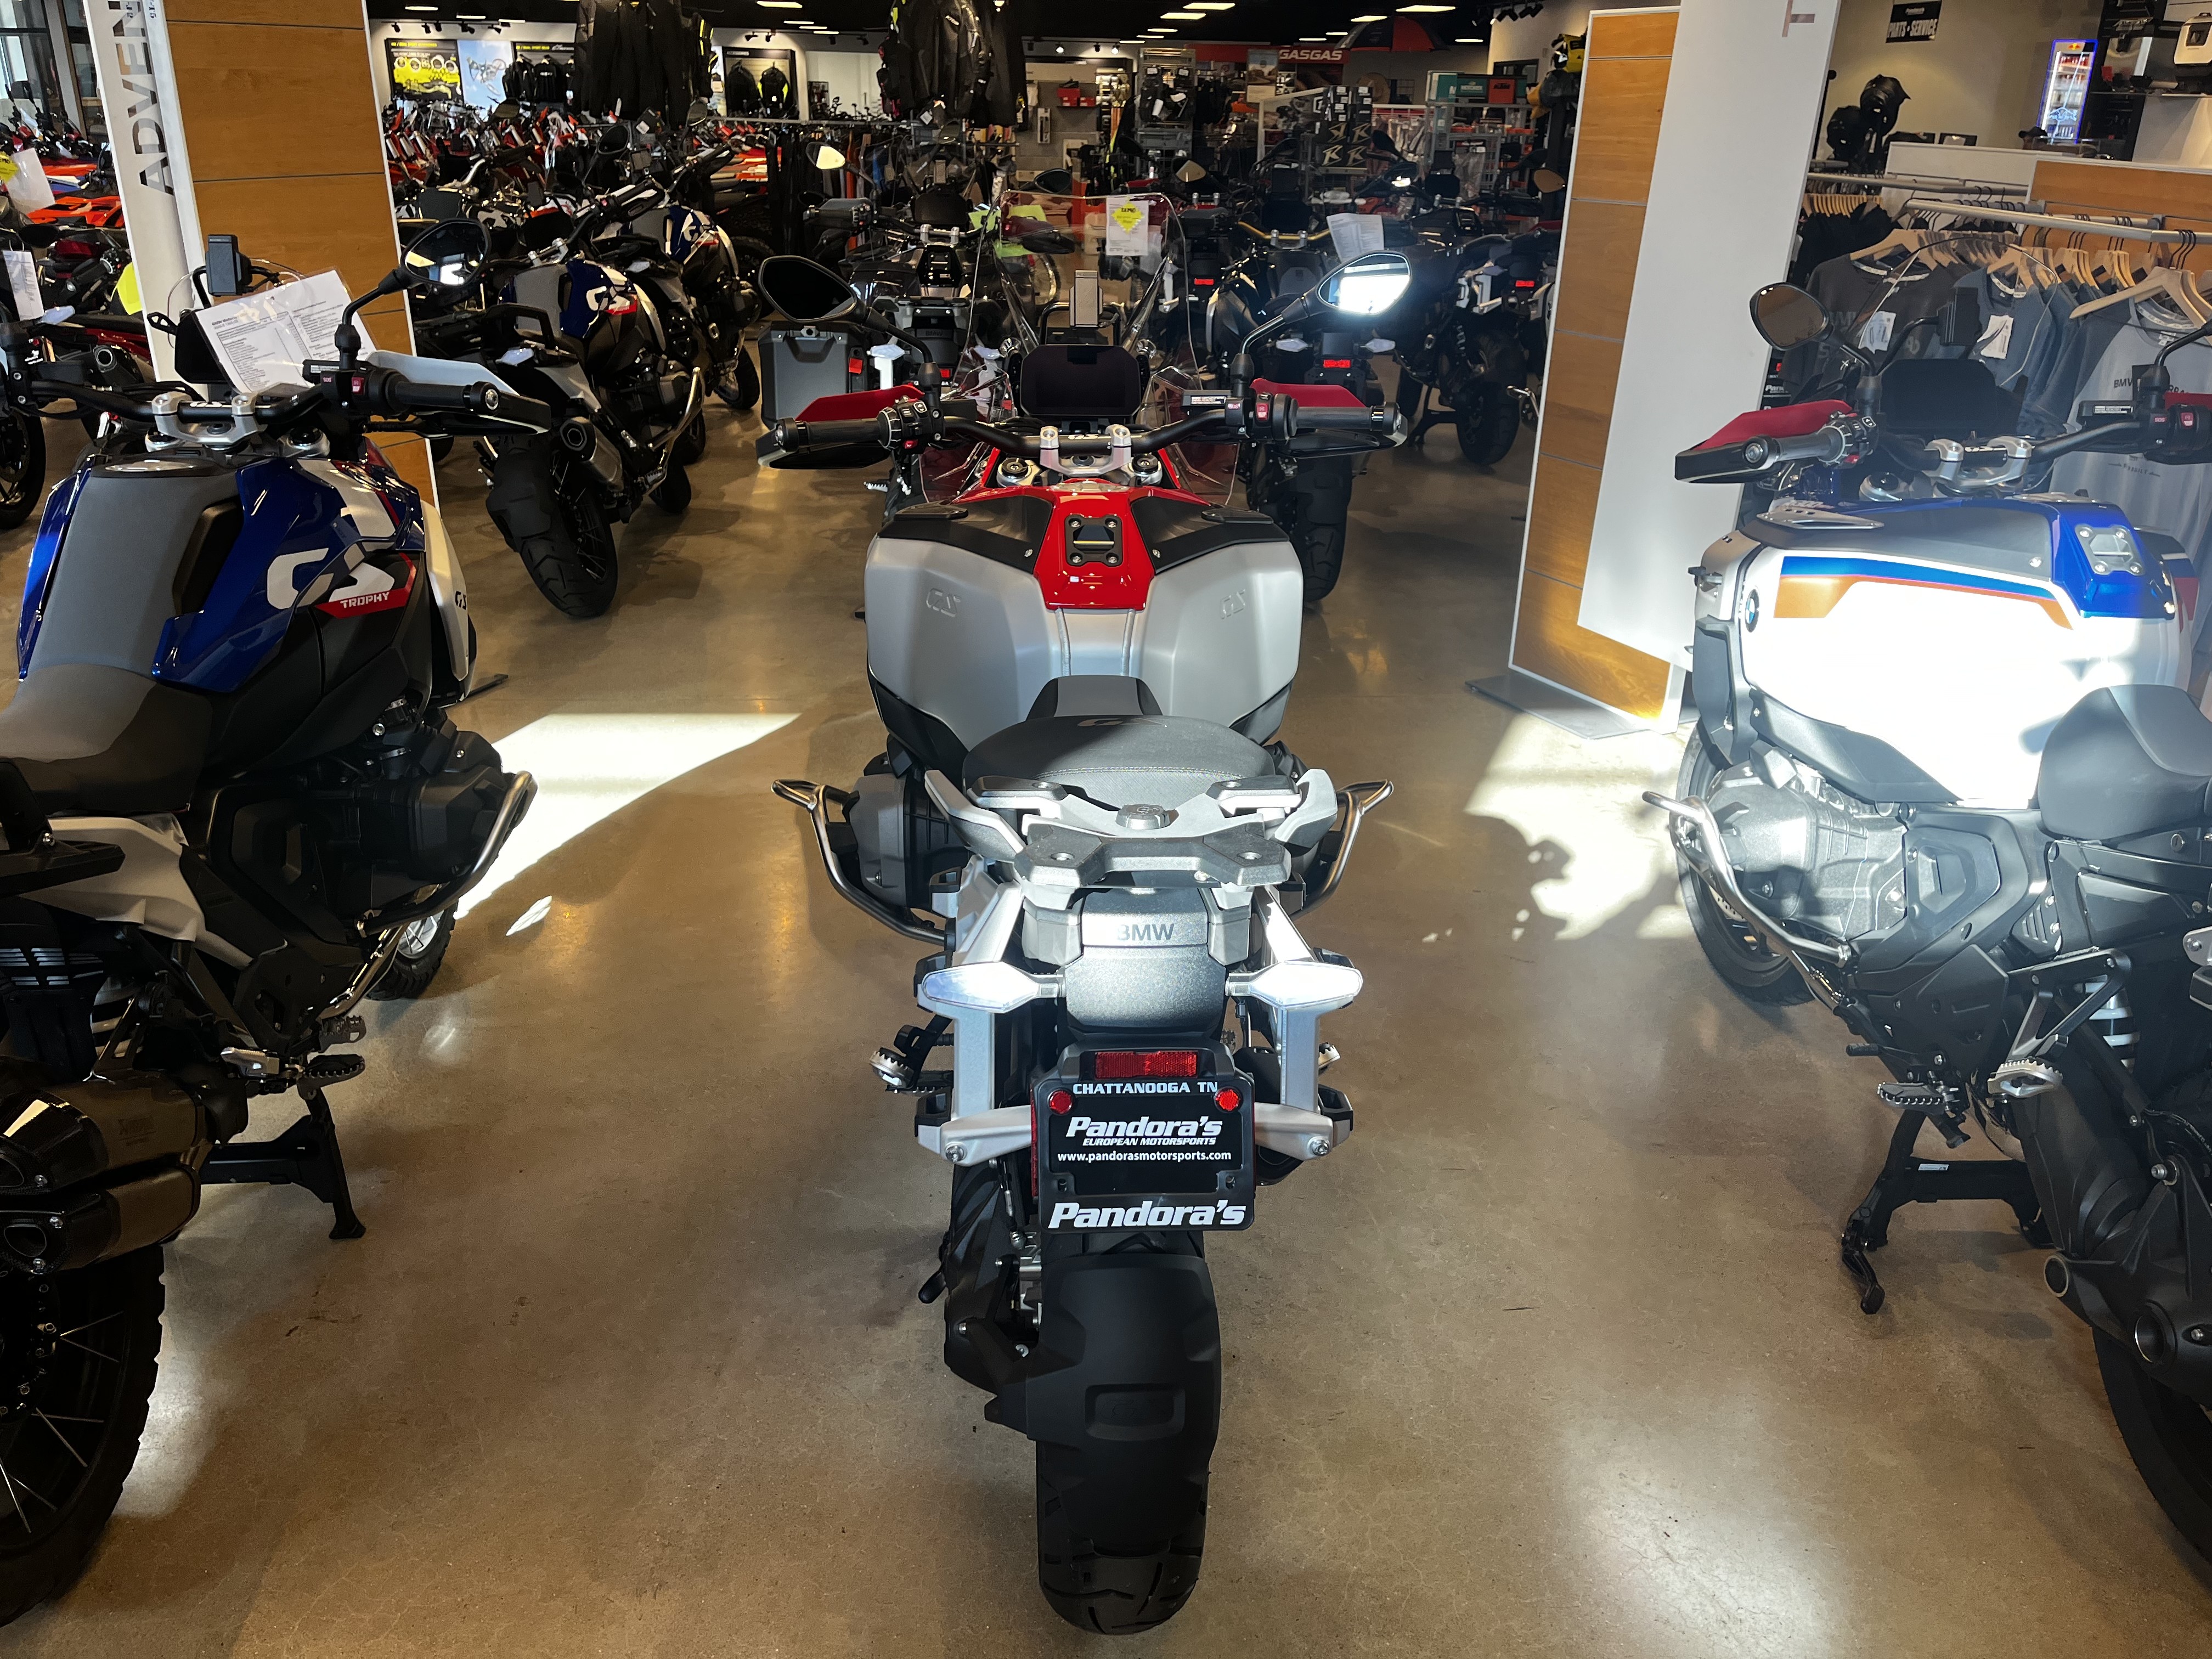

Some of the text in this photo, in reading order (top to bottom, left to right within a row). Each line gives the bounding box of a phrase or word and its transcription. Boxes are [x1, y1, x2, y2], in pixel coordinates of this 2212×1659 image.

[1279, 50, 1342, 60] GASGAS
[340, 591, 390, 609] TROPHY
[1117, 923, 1175, 941] BMW
[1073, 1081, 1218, 1094] CHATTANOOGA TN
[1065, 1116, 1223, 1138] Pandora's
[1082, 1137, 1217, 1146] EUROPEAN MOTORSPORTS
[1057, 1150, 1232, 1163] www.pandorasmotorsports.com
[1048, 1199, 1246, 1229] Pandora's
